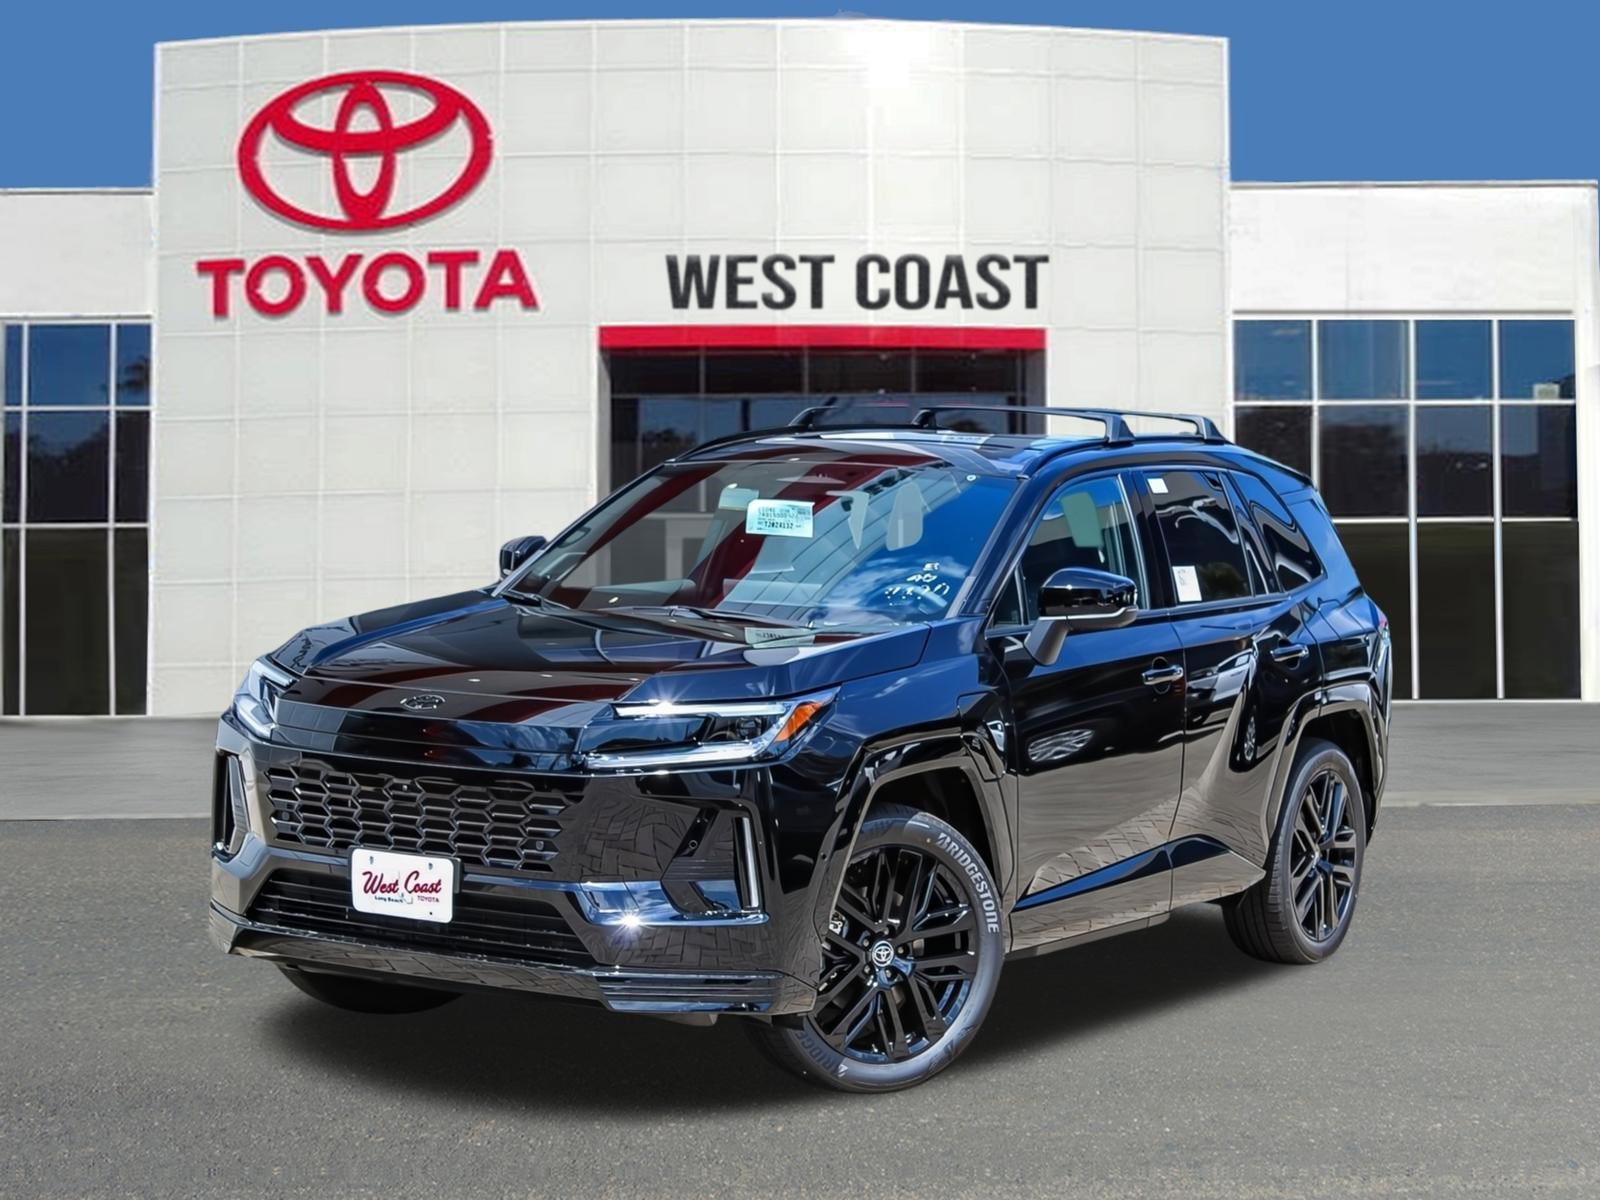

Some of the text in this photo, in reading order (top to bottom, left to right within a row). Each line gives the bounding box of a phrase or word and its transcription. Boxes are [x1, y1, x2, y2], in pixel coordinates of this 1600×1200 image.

[196, 249, 539, 317] TOYOTA
[665, 253, 1050, 310] WEST COAST
[362, 870, 442, 894] West Coast
[417, 895, 440, 903] TOYOTA
[936, 832, 1000, 934] BRIDGESTONE
